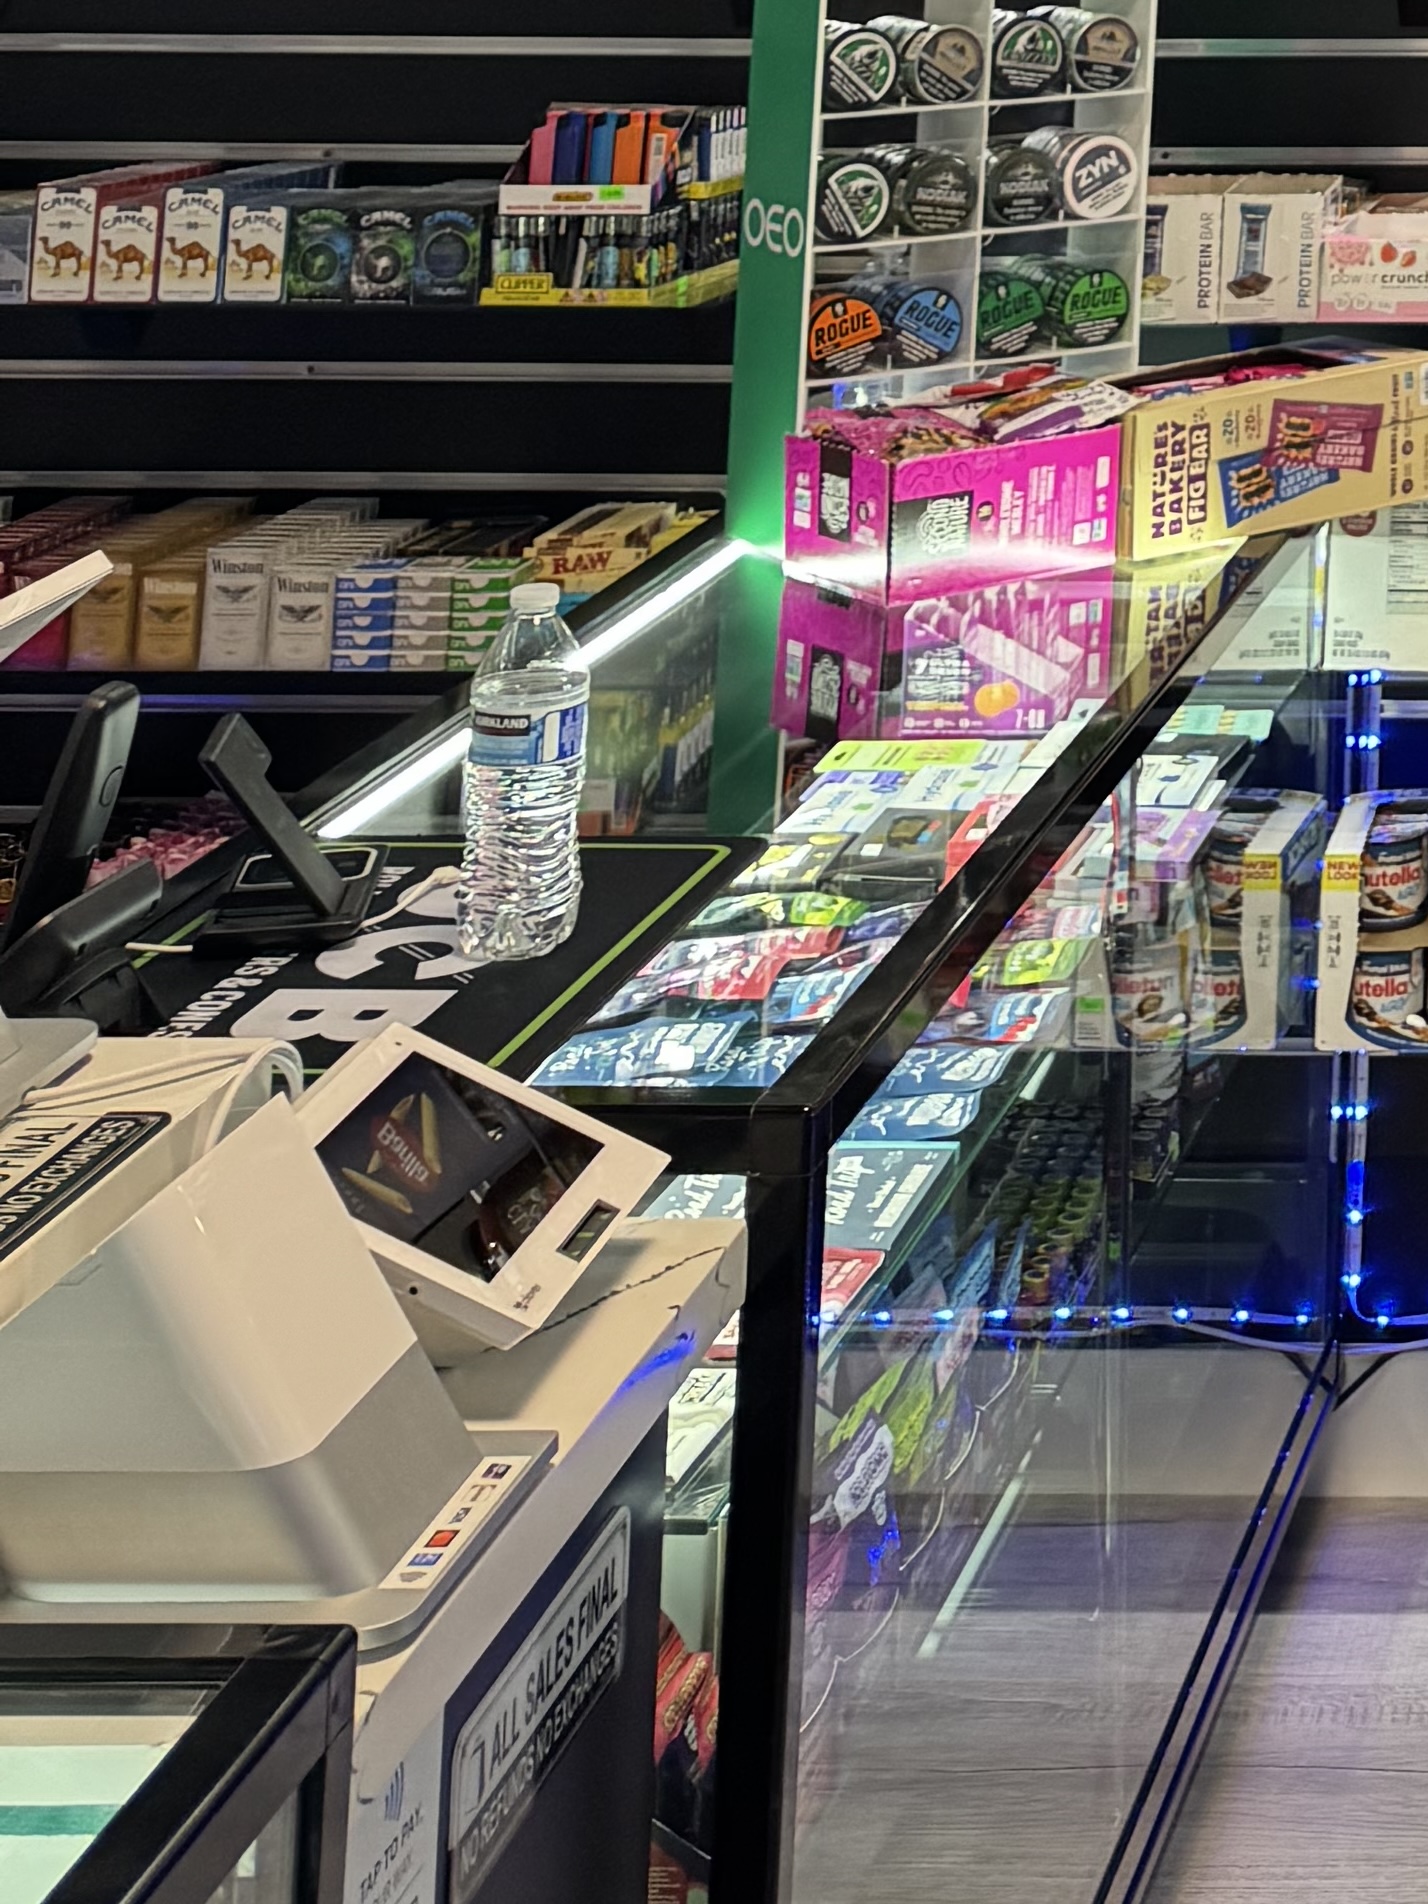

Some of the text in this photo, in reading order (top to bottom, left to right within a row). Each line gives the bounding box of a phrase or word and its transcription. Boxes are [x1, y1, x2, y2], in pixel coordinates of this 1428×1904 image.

[1075, 151, 1120, 187] ZYN
[41, 197, 94, 214] CAMEL
[168, 197, 221, 215] CAMEL
[102, 214, 153, 232] CAMEL
[232, 215, 284, 232] CAMEL
[360, 212, 412, 228] CAMEL
[744, 198, 802, 257] OEO
[1197, 212, 1213, 309] PROTEIN BAR
[979, 293, 1034, 326] ROGUE
[1069, 286, 1122, 310] ROGUE
[814, 311, 875, 344] ROGUE
[904, 299, 958, 338] ROGUE
[1169, 420, 1186, 535] BAKERY
[212, 558, 264, 574] Winston
[552, 551, 612, 574] RAW
[276, 575, 329, 593] Winston
[475, 716, 529, 729] KIRKLAND
[1327, 862, 1358, 871] NEW
[489, 1558, 618, 1780] ALL SALES FINAL
